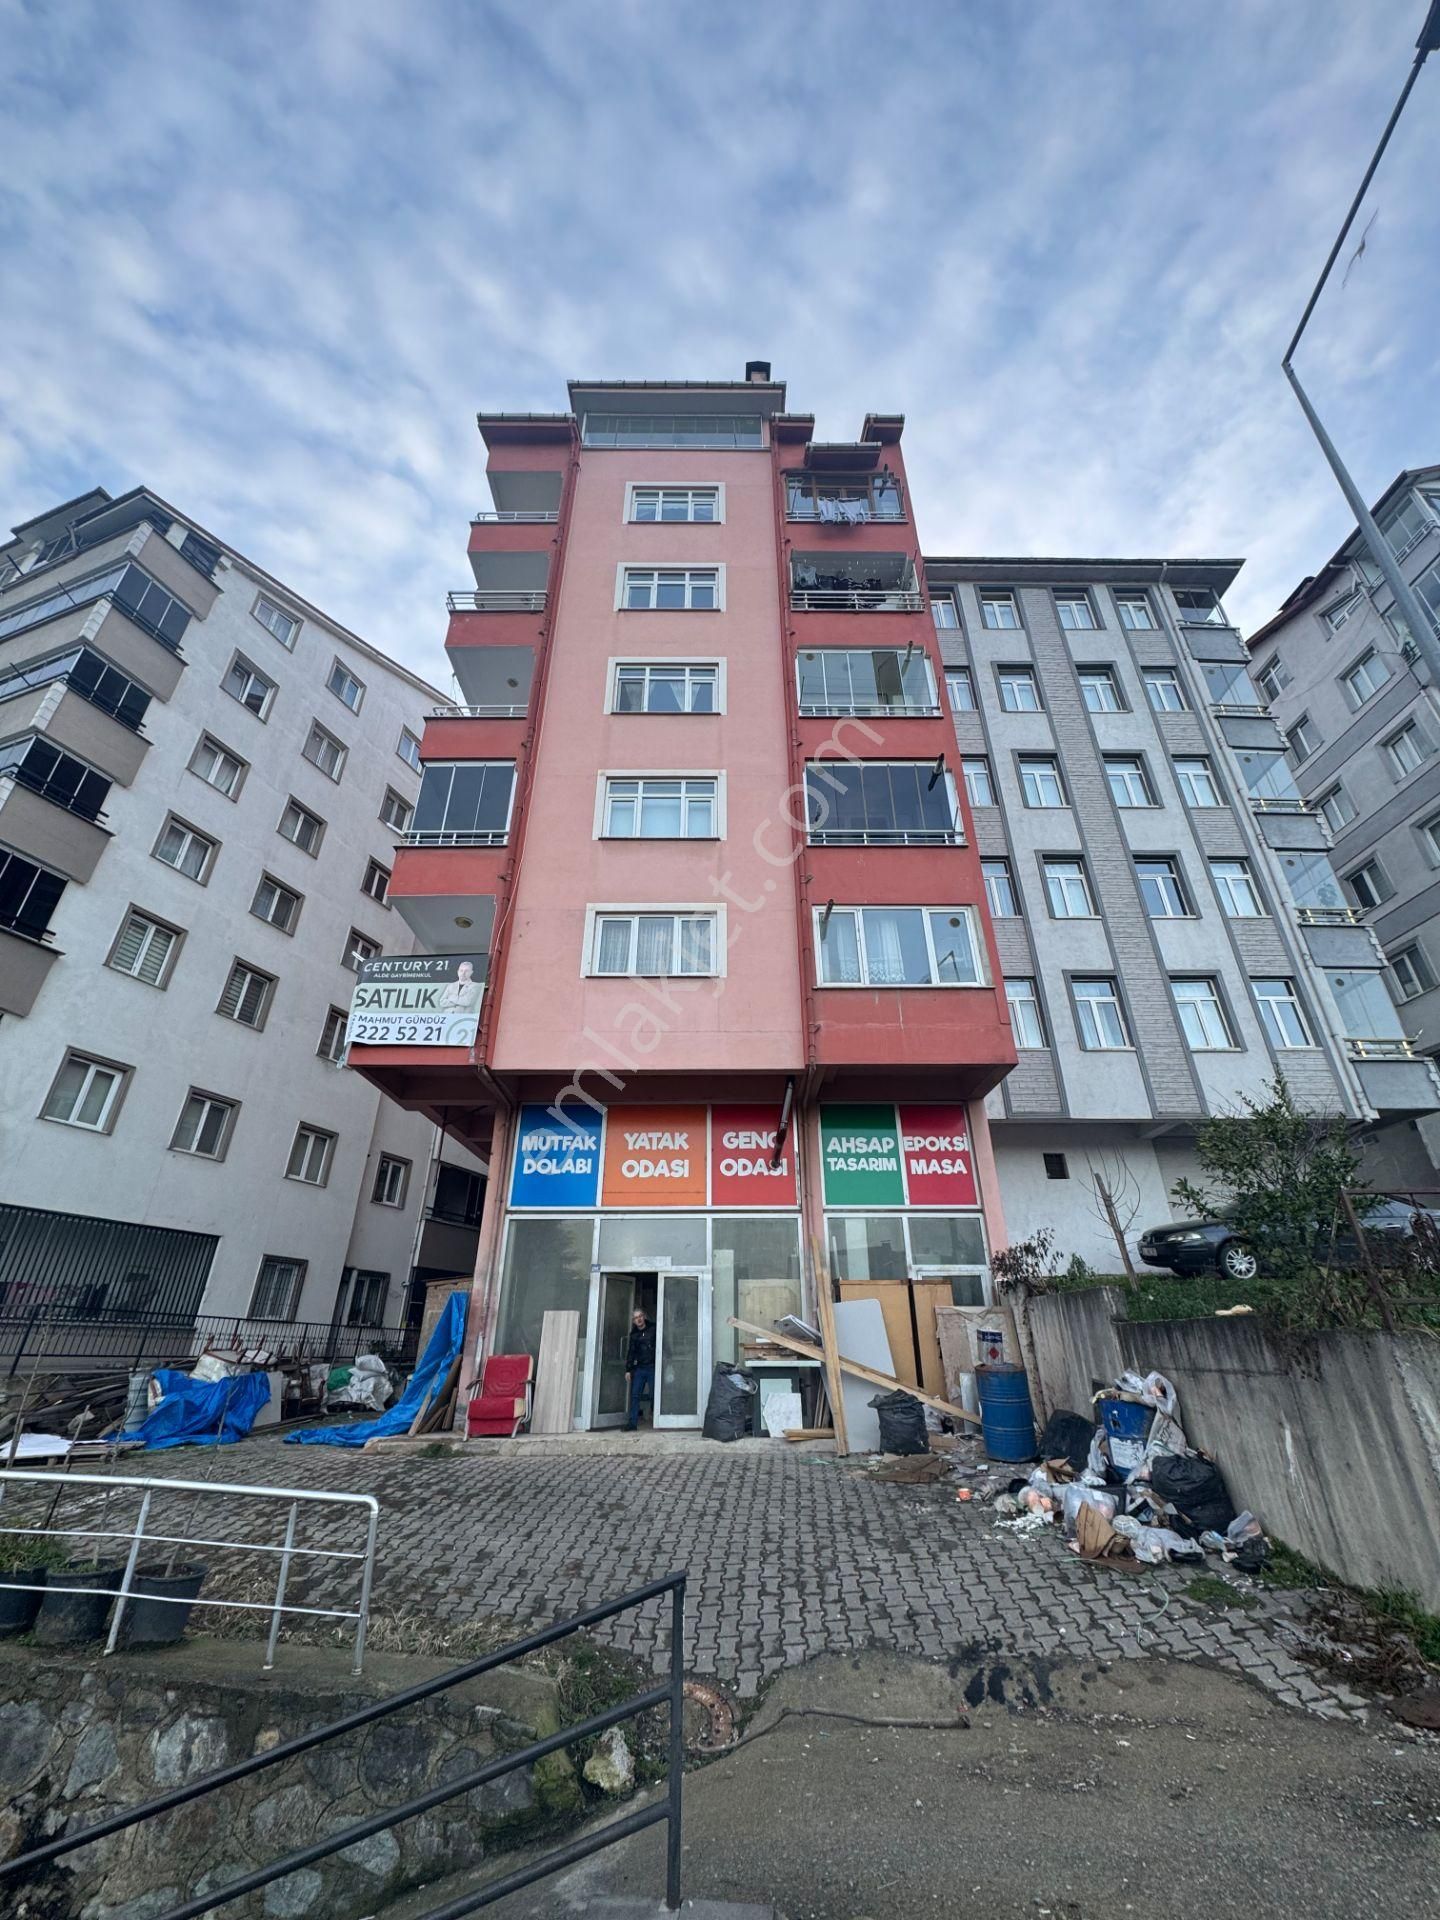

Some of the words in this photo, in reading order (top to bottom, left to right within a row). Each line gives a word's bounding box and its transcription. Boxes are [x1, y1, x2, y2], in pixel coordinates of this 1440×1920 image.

[364, 961, 433, 972] CENTURY
[436, 961, 449, 971] 21
[355, 988, 438, 1008] SATILIK
[358, 1015, 403, 1024] MAHMUT
[405, 1014, 447, 1025] GÜNDÜZ
[355, 1024, 390, 1041] 222
[395, 1026, 418, 1041] 52
[423, 1026, 442, 1042] 21
[521, 1135, 597, 1152] MUTFAK
[623, 1132, 689, 1151] YATAK
[903, 1133, 969, 1152] EPOKSİ
[522, 1158, 593, 1175] DOLABI
[621, 1159, 690, 1178] ODASI
[719, 1158, 788, 1177] ODASI
[827, 1158, 897, 1171] TASARIM
[910, 1158, 968, 1175] MASA
